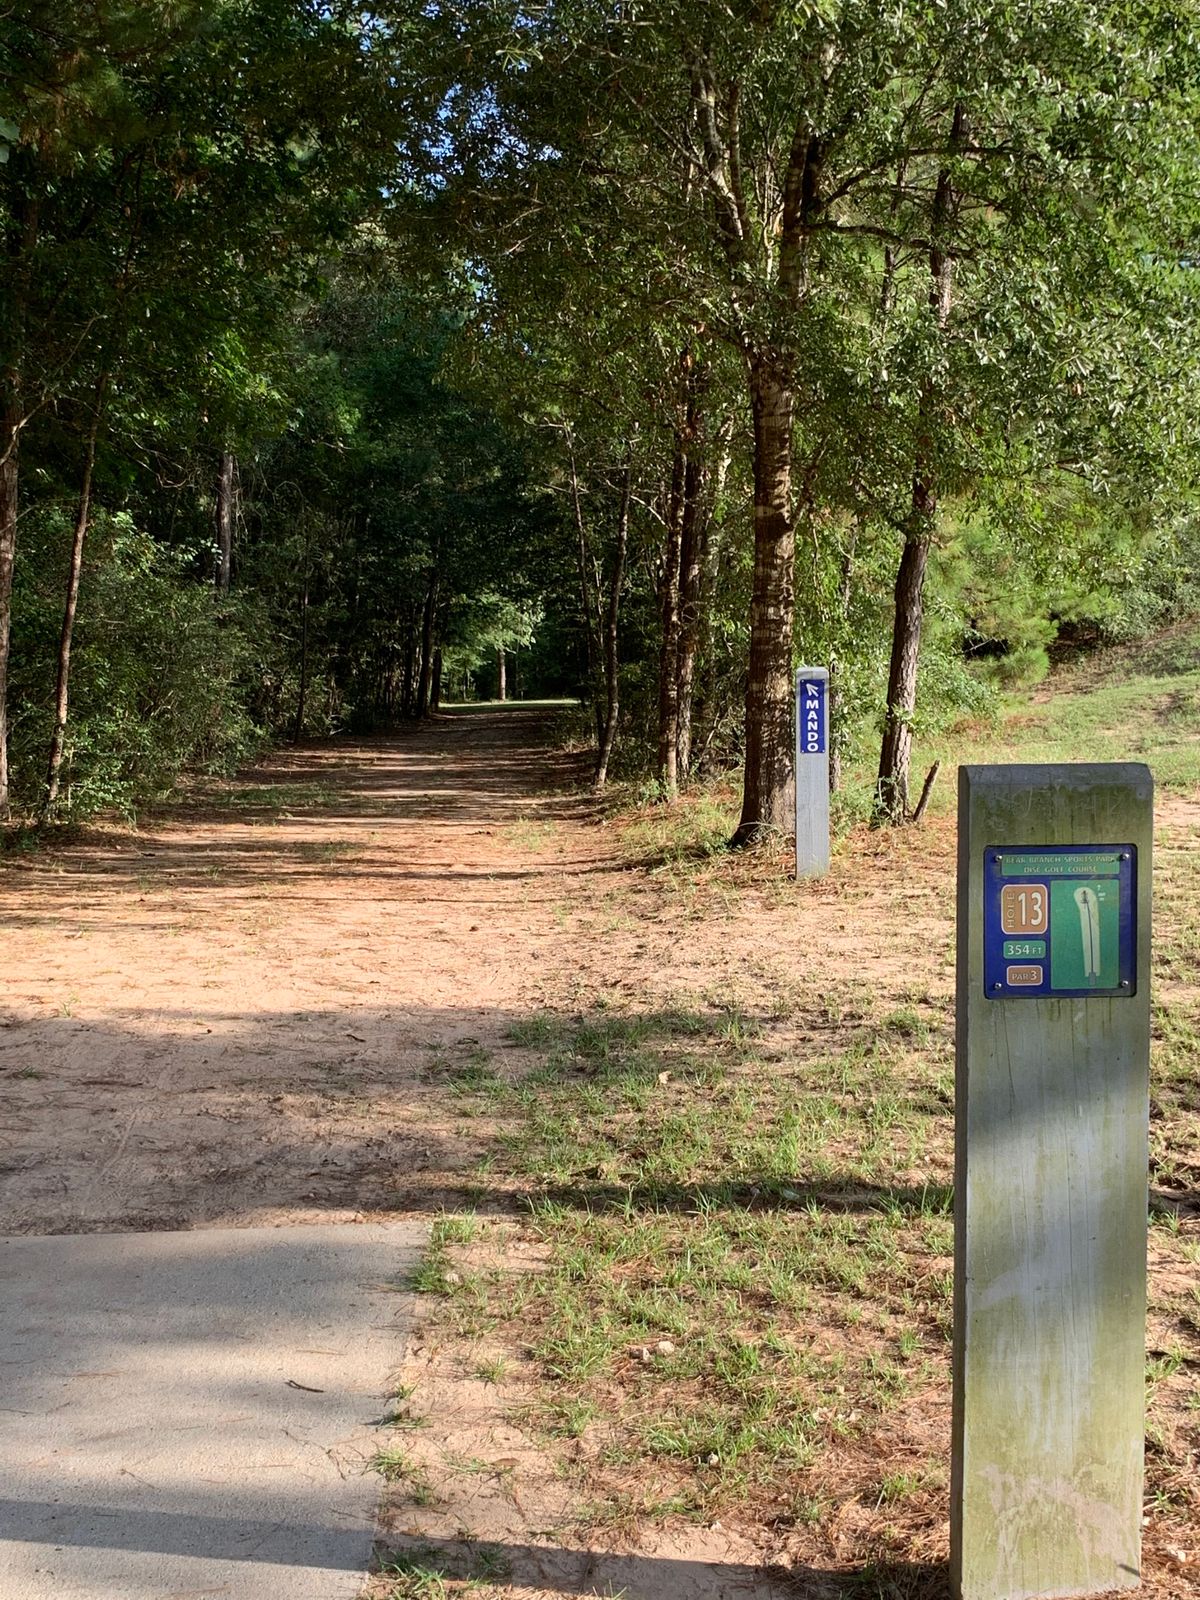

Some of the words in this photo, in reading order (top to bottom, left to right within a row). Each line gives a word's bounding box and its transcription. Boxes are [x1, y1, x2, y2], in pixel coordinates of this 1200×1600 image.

[806, 700, 819, 752] MANDO
[1007, 891, 1015, 928] HOLE
[1018, 892, 1043, 926] 13
[1007, 945, 1030, 955] 354
[1032, 947, 1042, 955] FT
[1012, 973, 1028, 981] PAR
[1031, 970, 1038, 981] 3
